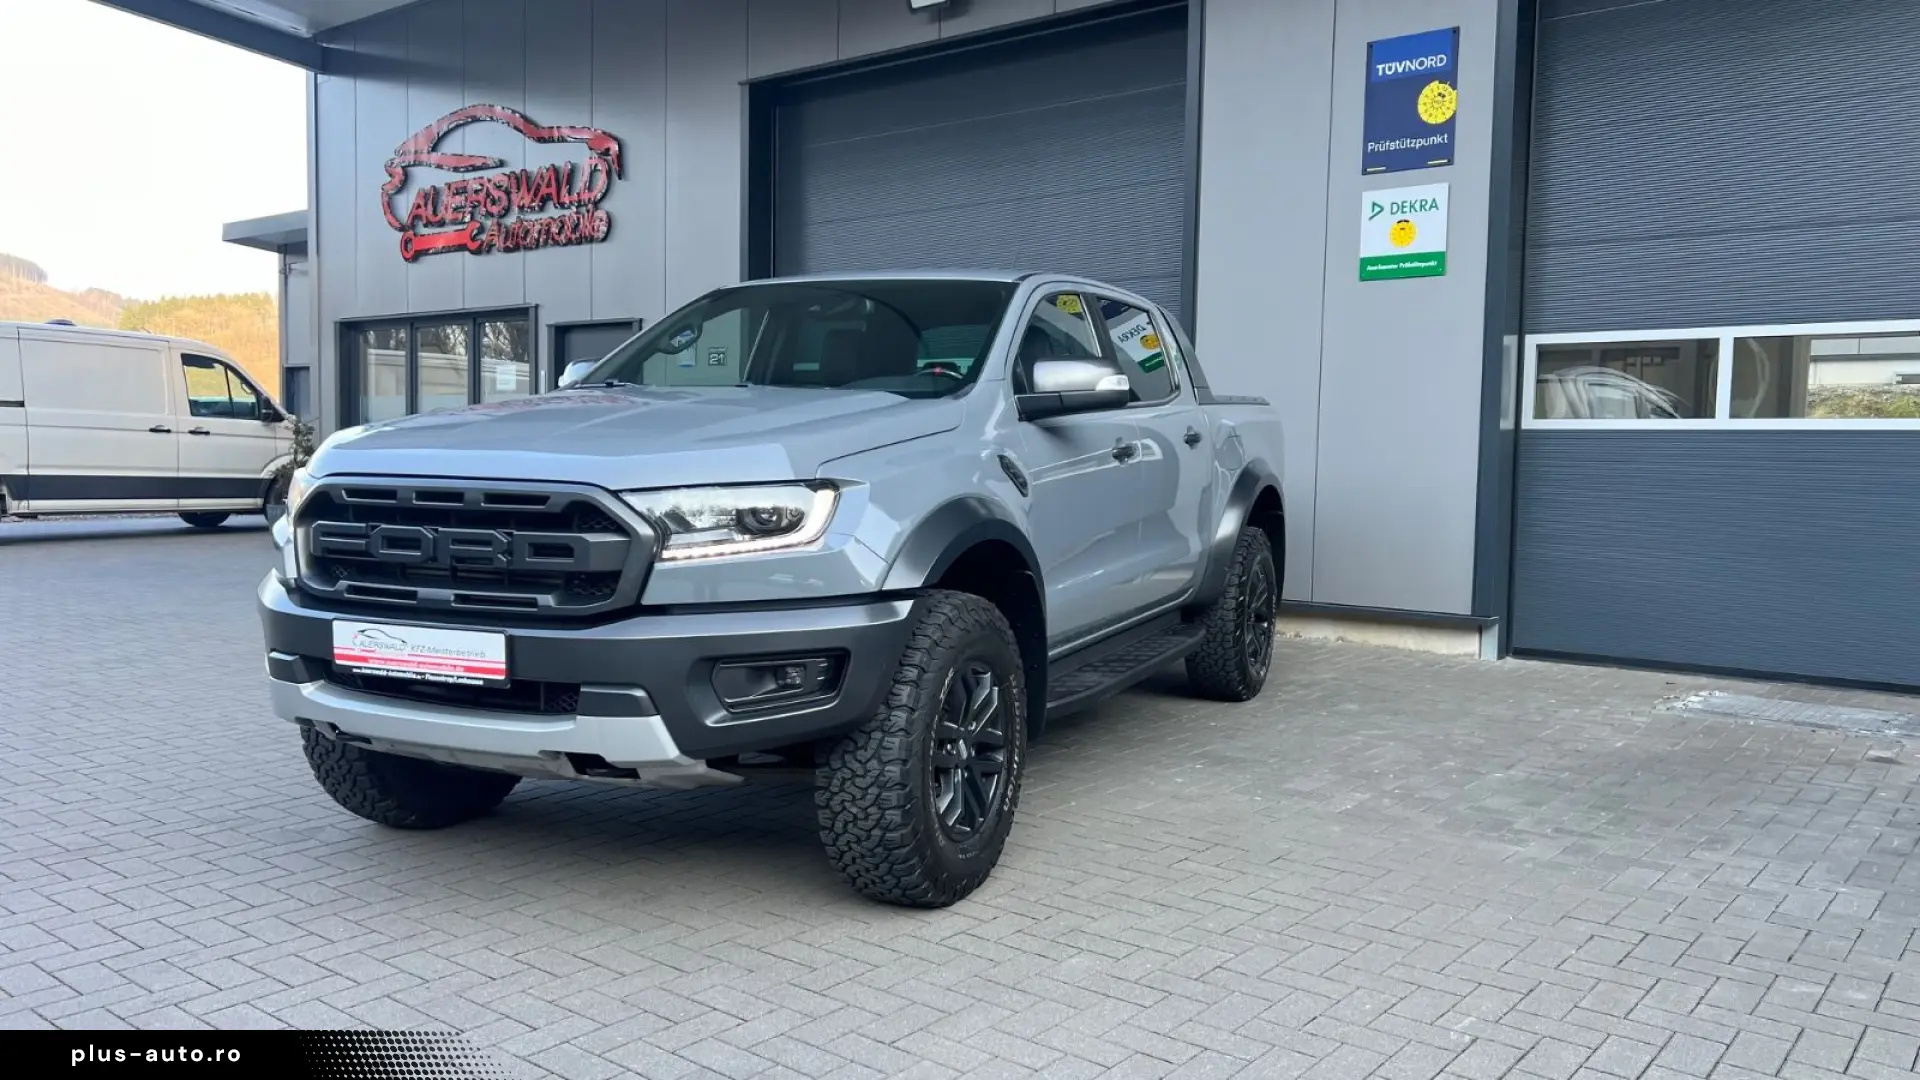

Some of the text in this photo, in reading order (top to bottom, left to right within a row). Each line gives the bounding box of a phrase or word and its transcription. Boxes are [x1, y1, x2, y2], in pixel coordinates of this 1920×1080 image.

[1367, 133, 1448, 153] Prüfstützpunkt
[407, 158, 608, 228] AUERSWALD
[1390, 198, 1439, 215] DEKRA
[709, 353, 725, 365] 21
[311, 520, 597, 571] FORD
